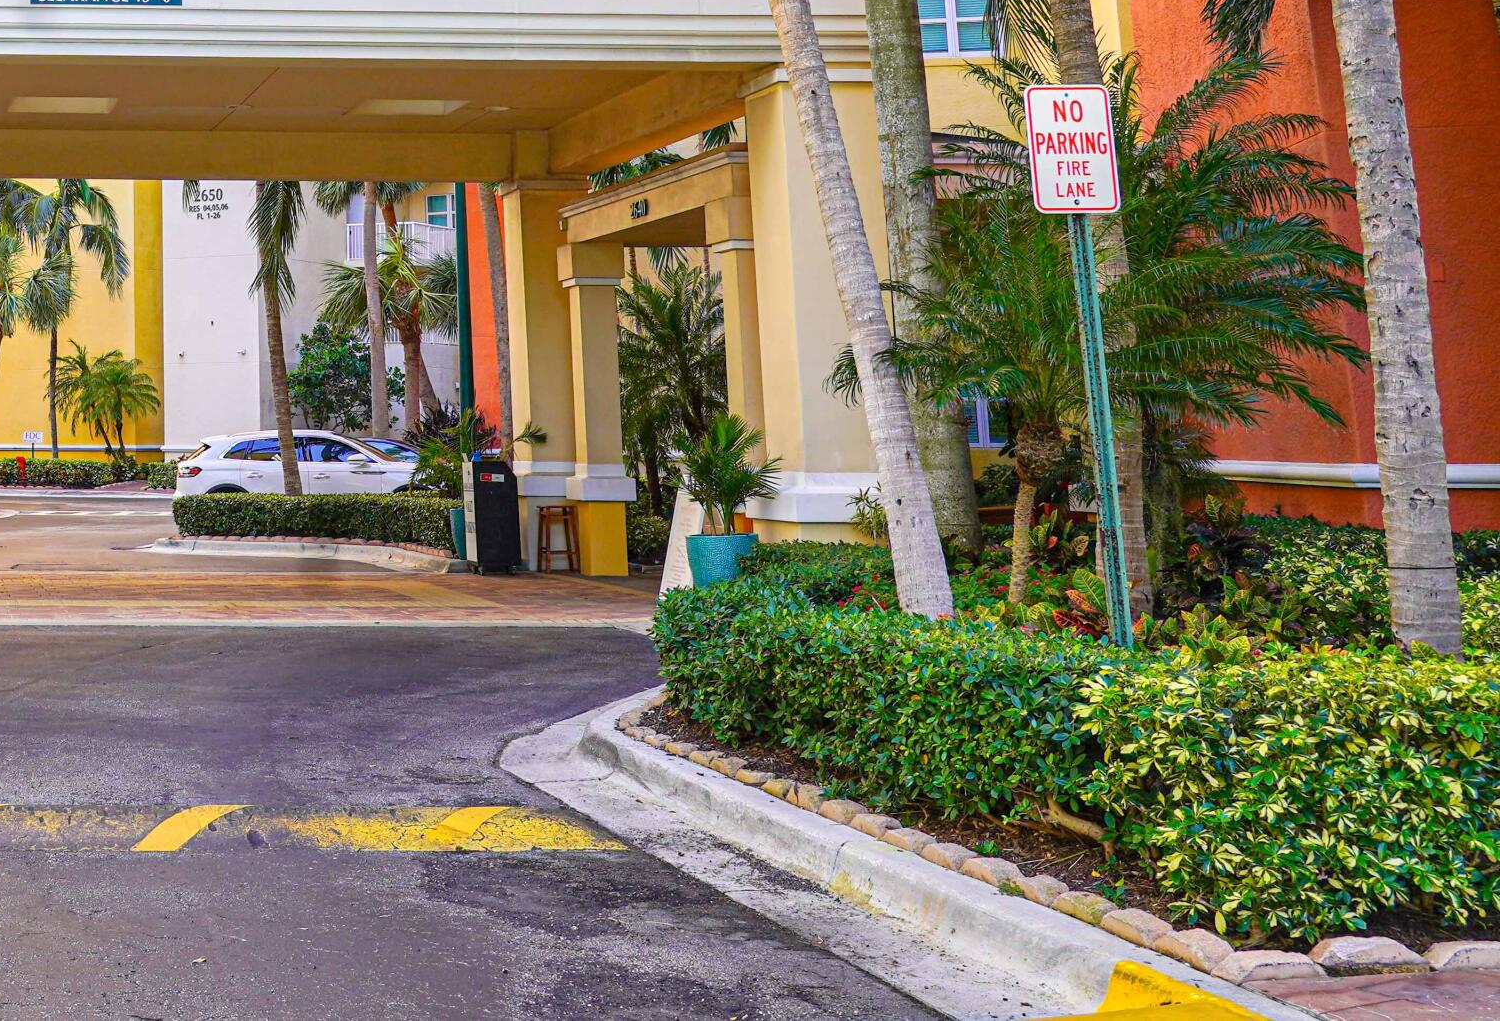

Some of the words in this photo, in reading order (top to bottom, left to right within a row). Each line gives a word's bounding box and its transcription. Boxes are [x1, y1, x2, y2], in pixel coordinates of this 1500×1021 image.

[1052, 99, 1084, 123] NO
[1035, 131, 1108, 155] PARKING
[1057, 160, 1092, 176] FIRE
[194, 189, 223, 201] 2650
[1055, 182, 1097, 198] LANE
